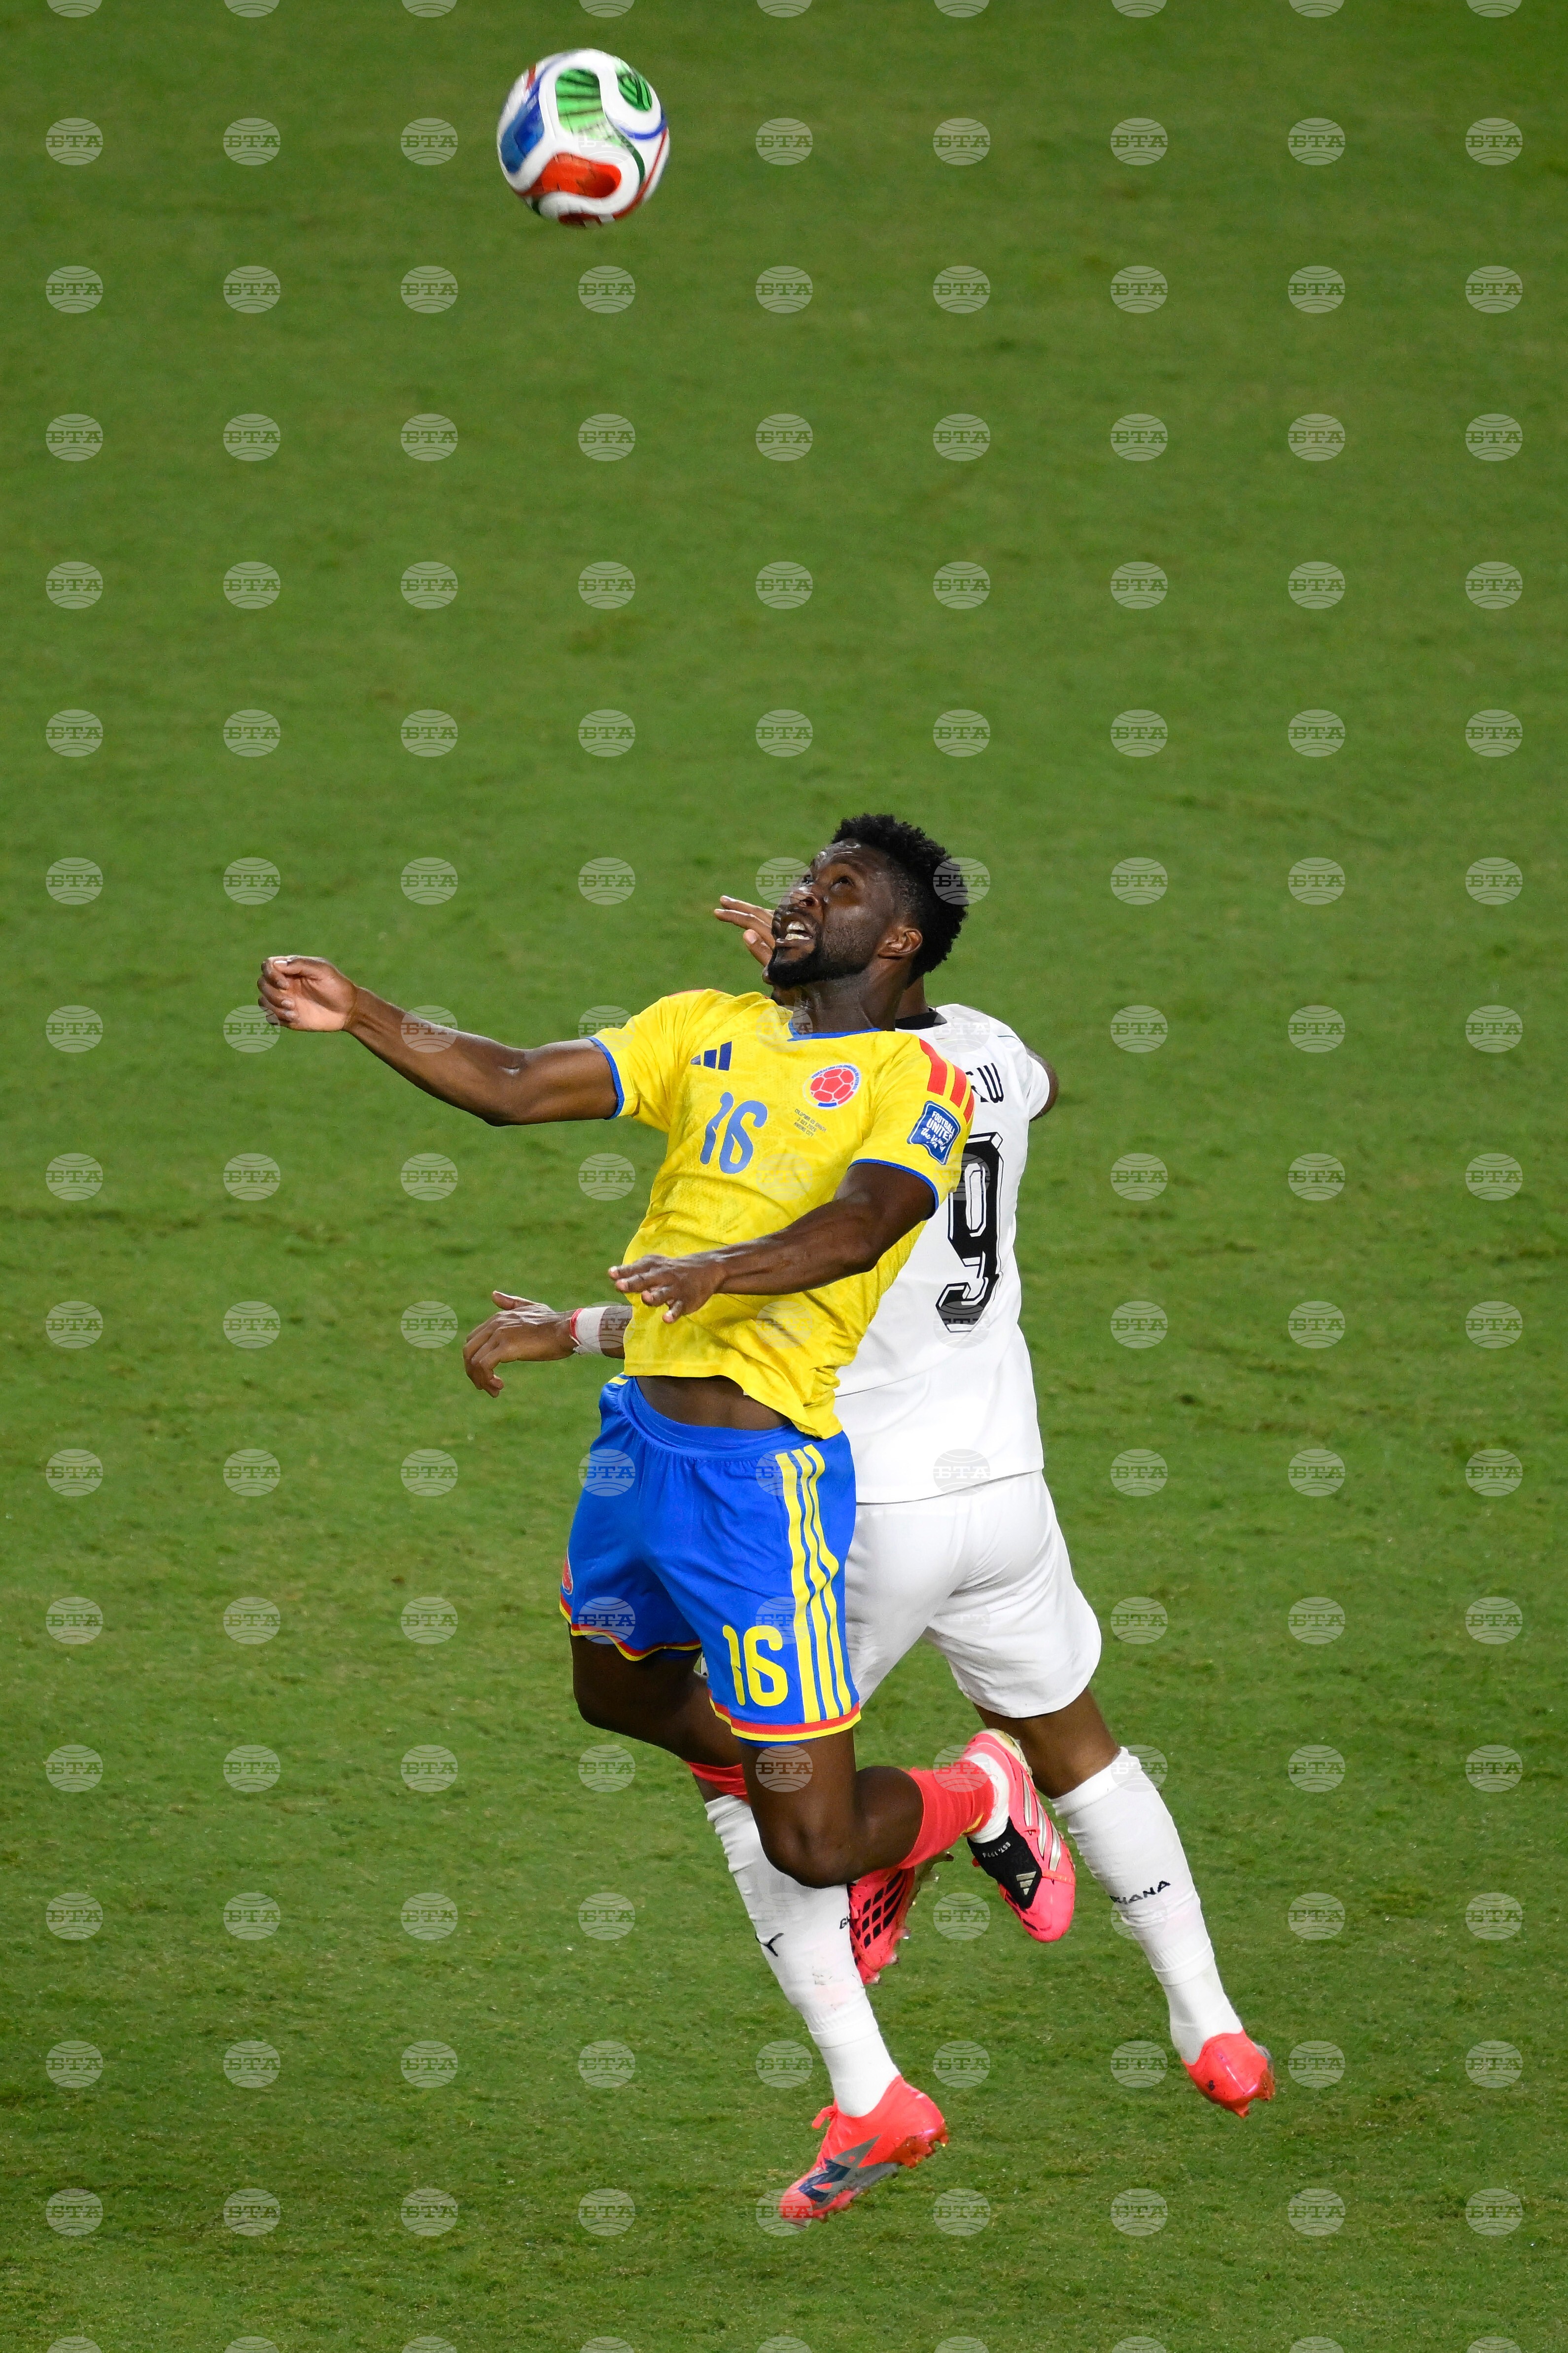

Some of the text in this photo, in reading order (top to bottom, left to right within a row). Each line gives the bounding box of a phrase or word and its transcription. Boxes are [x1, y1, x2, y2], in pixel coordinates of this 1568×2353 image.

[700, 1091, 767, 1174] 16
[921, 1127, 931, 1139] the
[926, 1118, 953, 1144] UNITES
[932, 1111, 955, 1136] FOOTBALL
[936, 1132, 1004, 1333] 9
[723, 1624, 789, 1707] 16
[998, 1841, 1011, 1854] EST.
